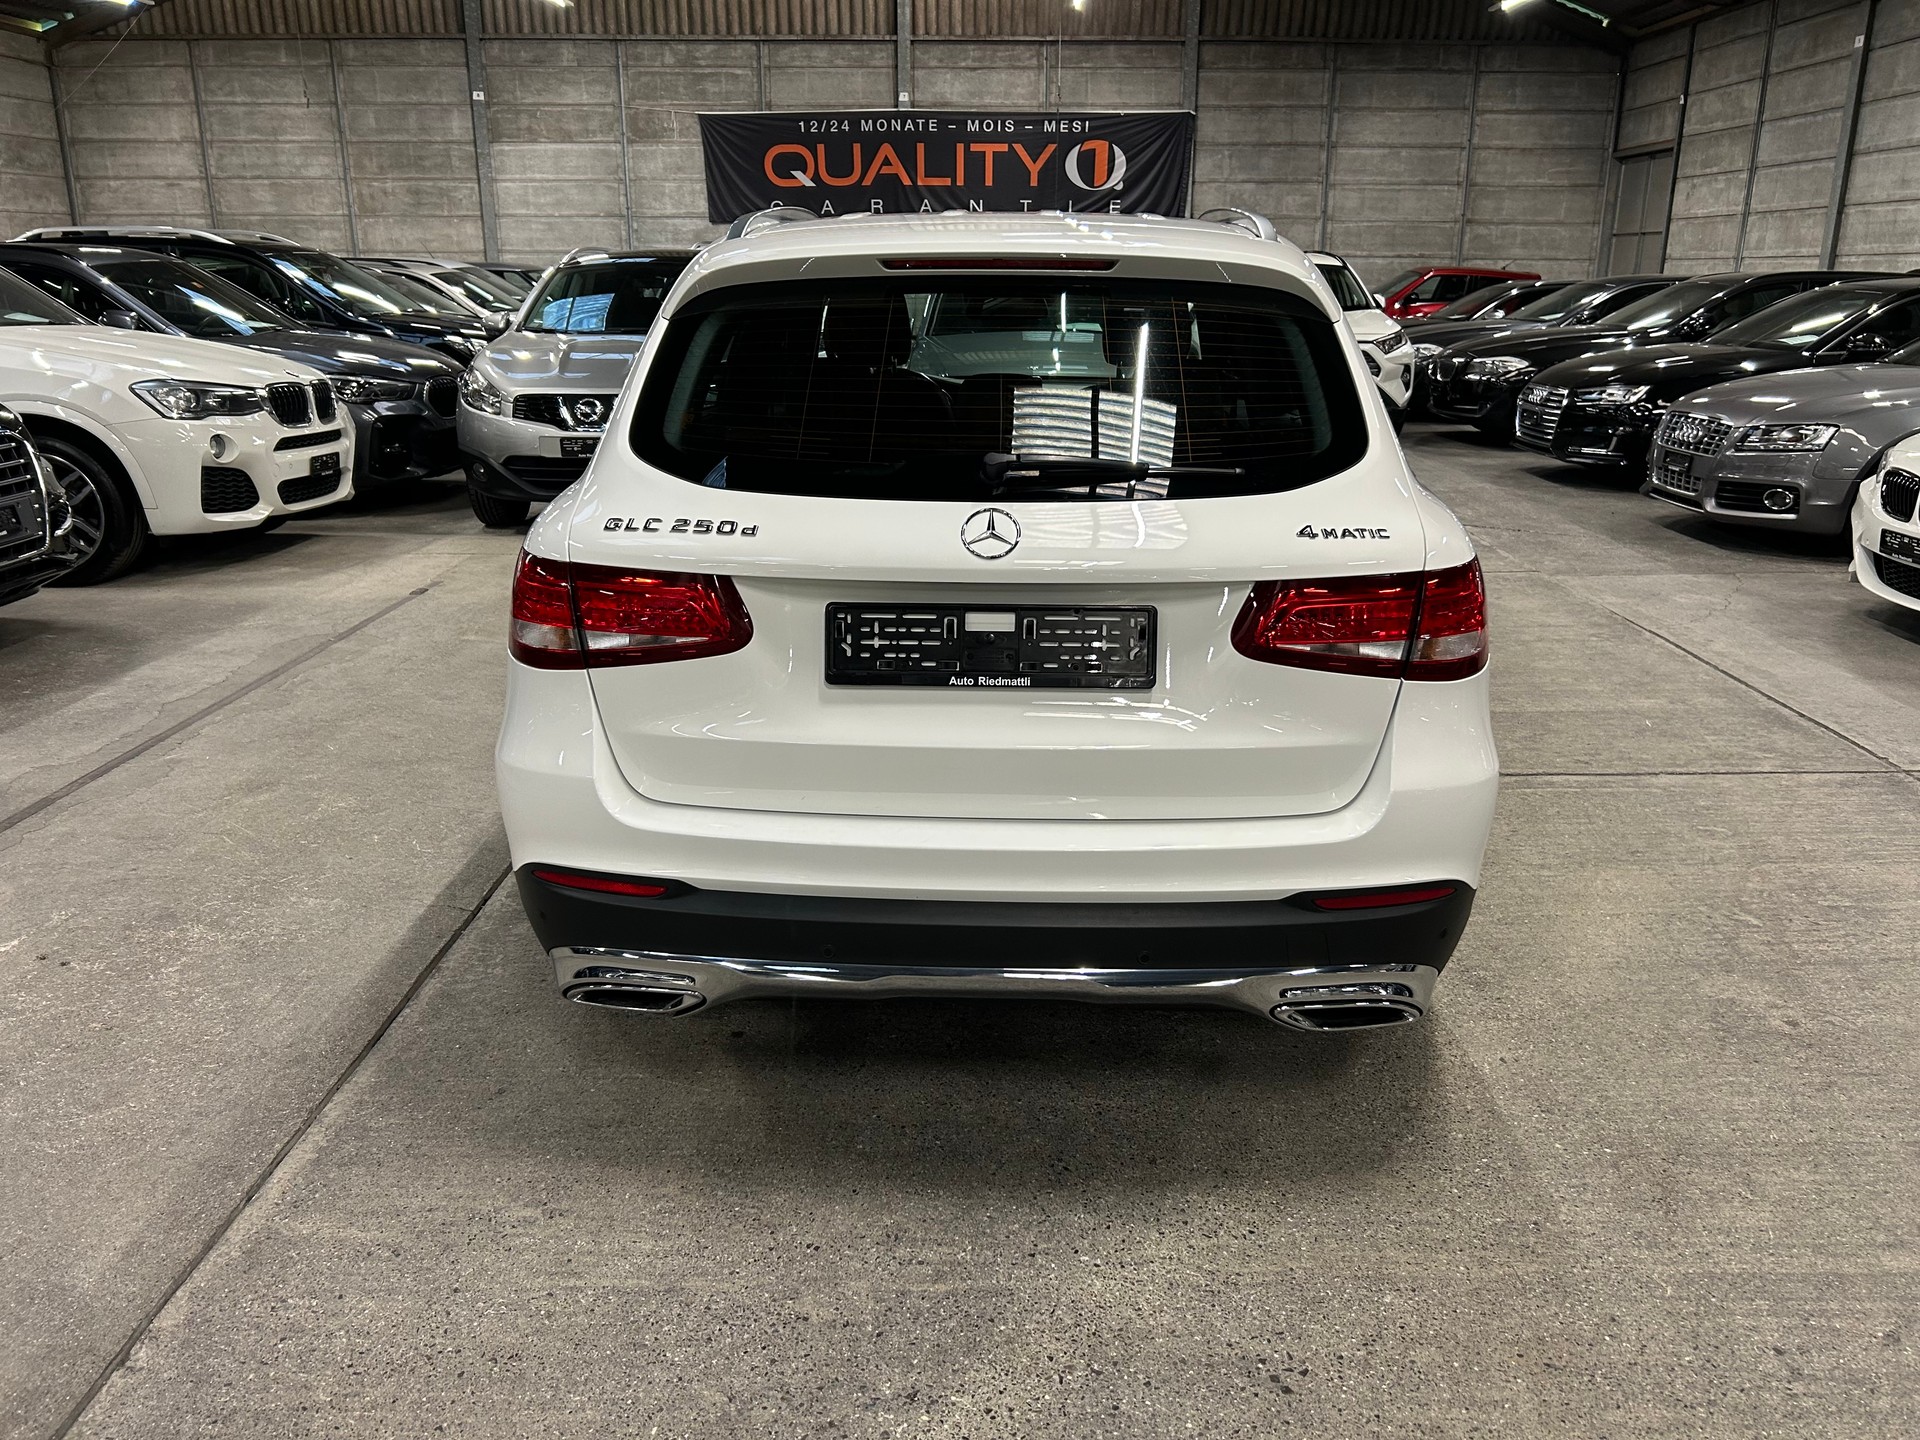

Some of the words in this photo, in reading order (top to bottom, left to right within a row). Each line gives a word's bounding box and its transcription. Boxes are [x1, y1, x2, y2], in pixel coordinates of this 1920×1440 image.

[799, 119, 850, 132] 12/24
[860, 119, 938, 132] MONATE
[967, 119, 1015, 132] MOIS
[1043, 120, 1090, 133] MESI
[764, 142, 1058, 188] QUALITY
[603, 517, 664, 533] GLC
[949, 676, 975, 686] Auto
[978, 676, 1031, 687] Riedmattli
